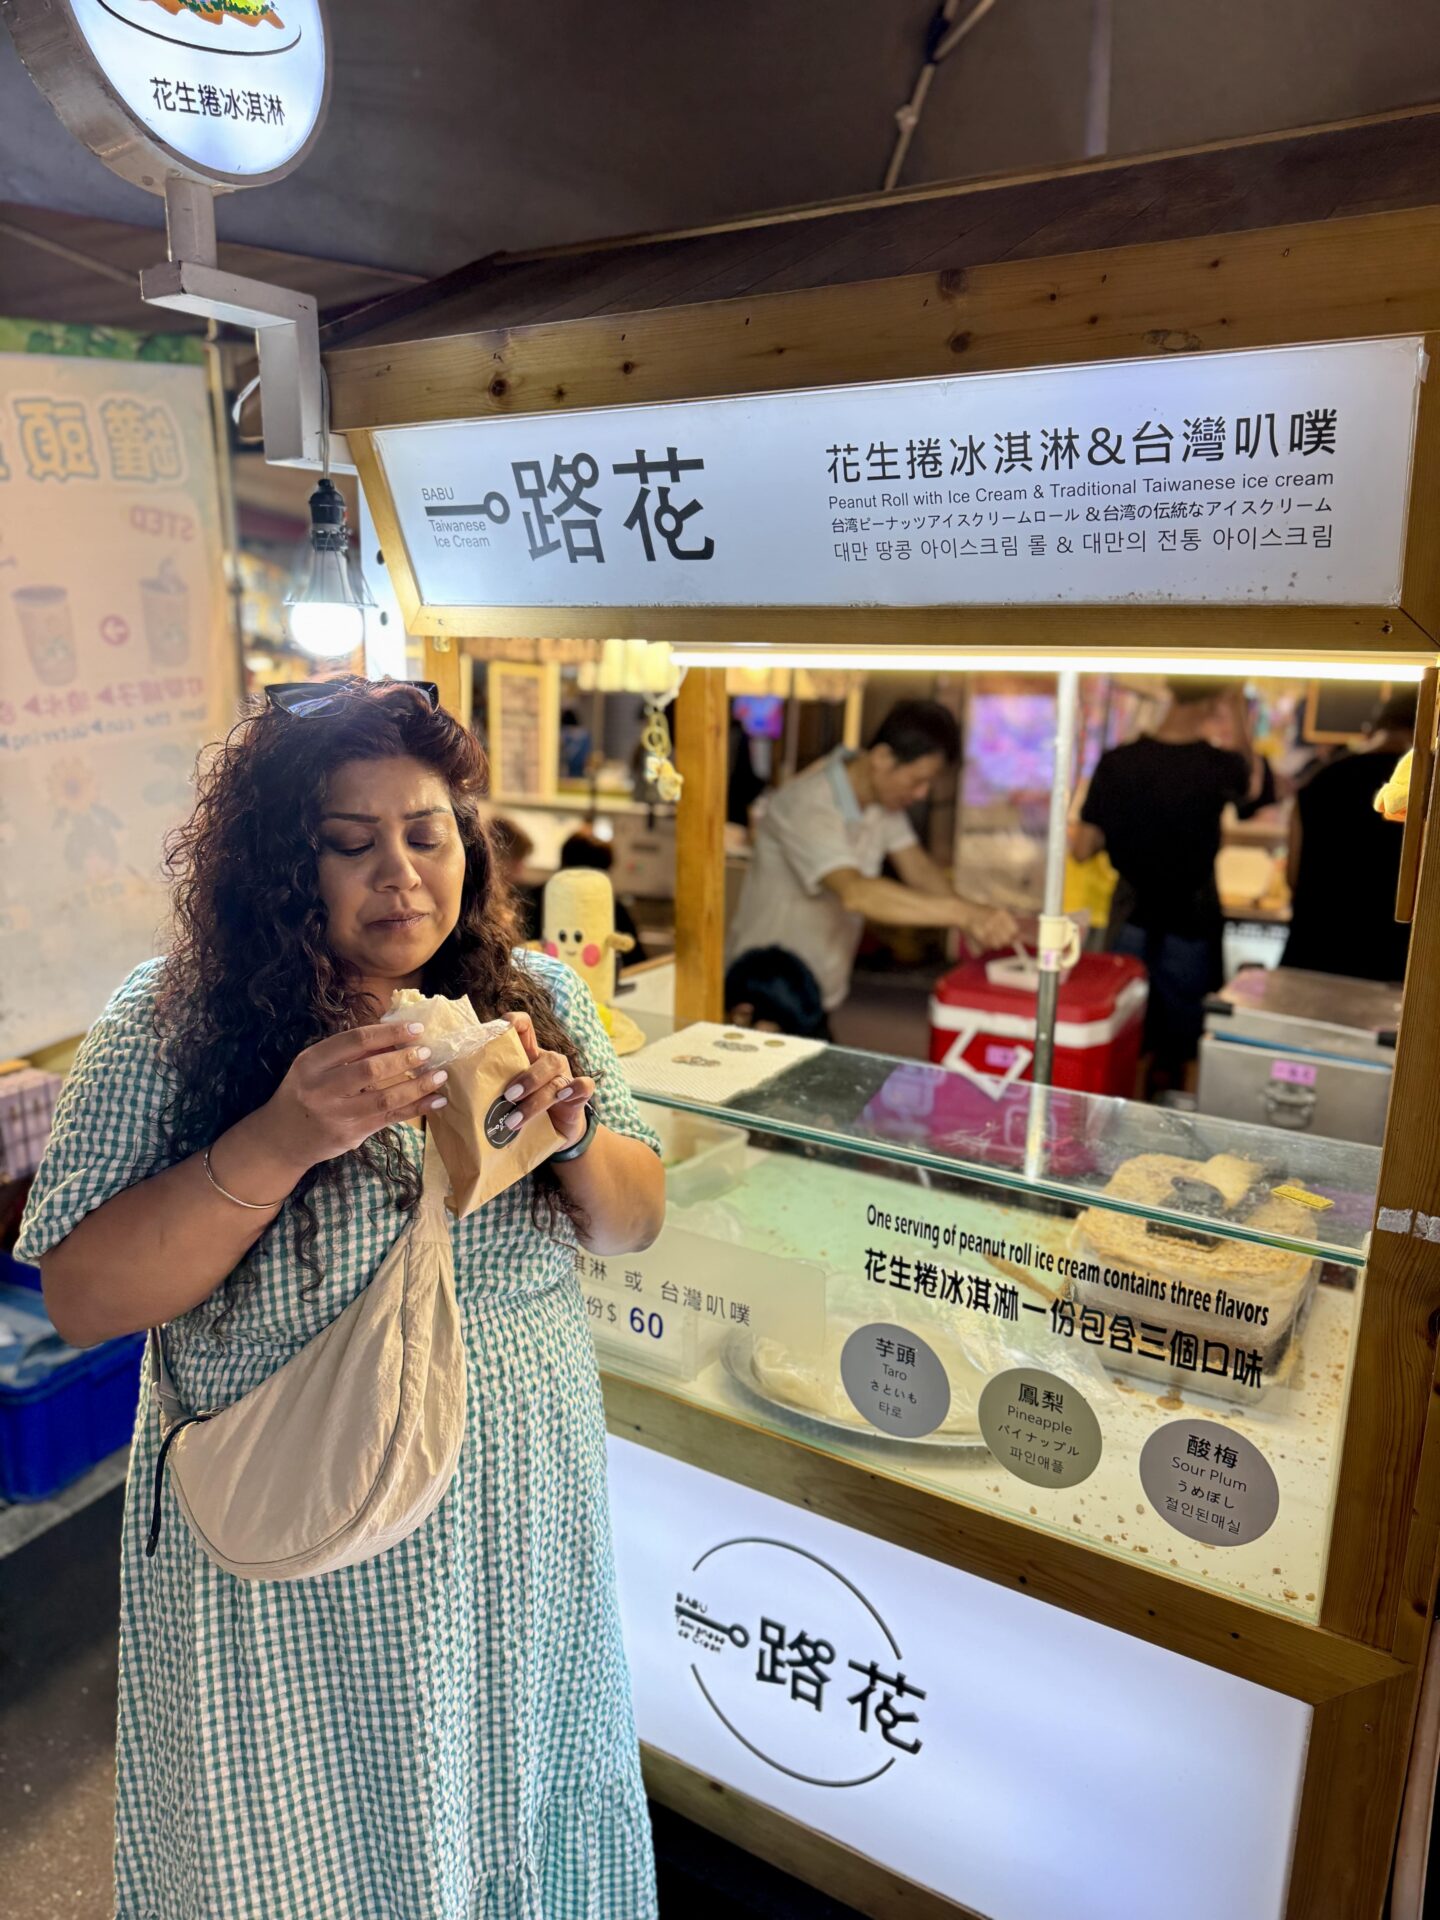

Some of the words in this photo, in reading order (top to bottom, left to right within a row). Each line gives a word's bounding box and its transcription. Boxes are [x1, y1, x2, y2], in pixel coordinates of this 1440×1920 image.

[149, 77, 285, 126] 花生捲冰淇淋
[421, 488, 455, 501] BABU
[828, 494, 877, 510] Peanut
[882, 493, 909, 507] Roll
[913, 490, 943, 505] with
[949, 490, 970, 504] Ice
[975, 487, 1028, 502] Cream
[1033, 485, 1045, 499] &
[1050, 479, 1137, 498] Traditional
[1143, 475, 1236, 493] Taiwanese
[1242, 473, 1268, 489] ice
[1275, 472, 1334, 488] cream
[428, 519, 487, 533] Taiwanese
[434, 535, 451, 548] Ice
[453, 534, 491, 548] Cream
[834, 541, 868, 562] 대만
[876, 540, 912, 561] 땅콩
[920, 535, 1018, 559] 아이스크림
[1028, 534, 1047, 556] 롤
[1056, 536, 1074, 554] &
[1083, 530, 1146, 554] 대만의
[1158, 528, 1202, 551] 전통
[1213, 524, 1333, 550] 아이스크림
[867, 1204, 892, 1230] One
[894, 1216, 940, 1249] serving
[943, 1224, 957, 1246] of
[959, 1230, 1006, 1260] peanut
[1009, 1242, 1032, 1266] roll
[1034, 1245, 1054, 1272] ice
[1057, 1256, 1100, 1284] cream
[1103, 1267, 1166, 1301] contains
[1171, 1281, 1211, 1312] three
[1215, 1289, 1269, 1326] flavors
[624, 1270, 643, 1292] 或
[661, 1281, 750, 1327] 台灣叭噗
[630, 1307, 663, 1339] 60
[864, 1248, 1263, 1388] 花生捲冰淇淋一份包含三個口味
[875, 1337, 917, 1368] 芋頭
[882, 1363, 907, 1381] Taro
[870, 1379, 917, 1405] さといも
[1018, 1383, 1064, 1414] 鳳梨
[878, 1402, 903, 1419] 타로
[1007, 1405, 1072, 1435] Pineapple
[1009, 1446, 1064, 1474] 파인애플
[1186, 1433, 1239, 1469] 酸梅
[1170, 1456, 1206, 1478] Sour
[1210, 1468, 1247, 1493] Plum
